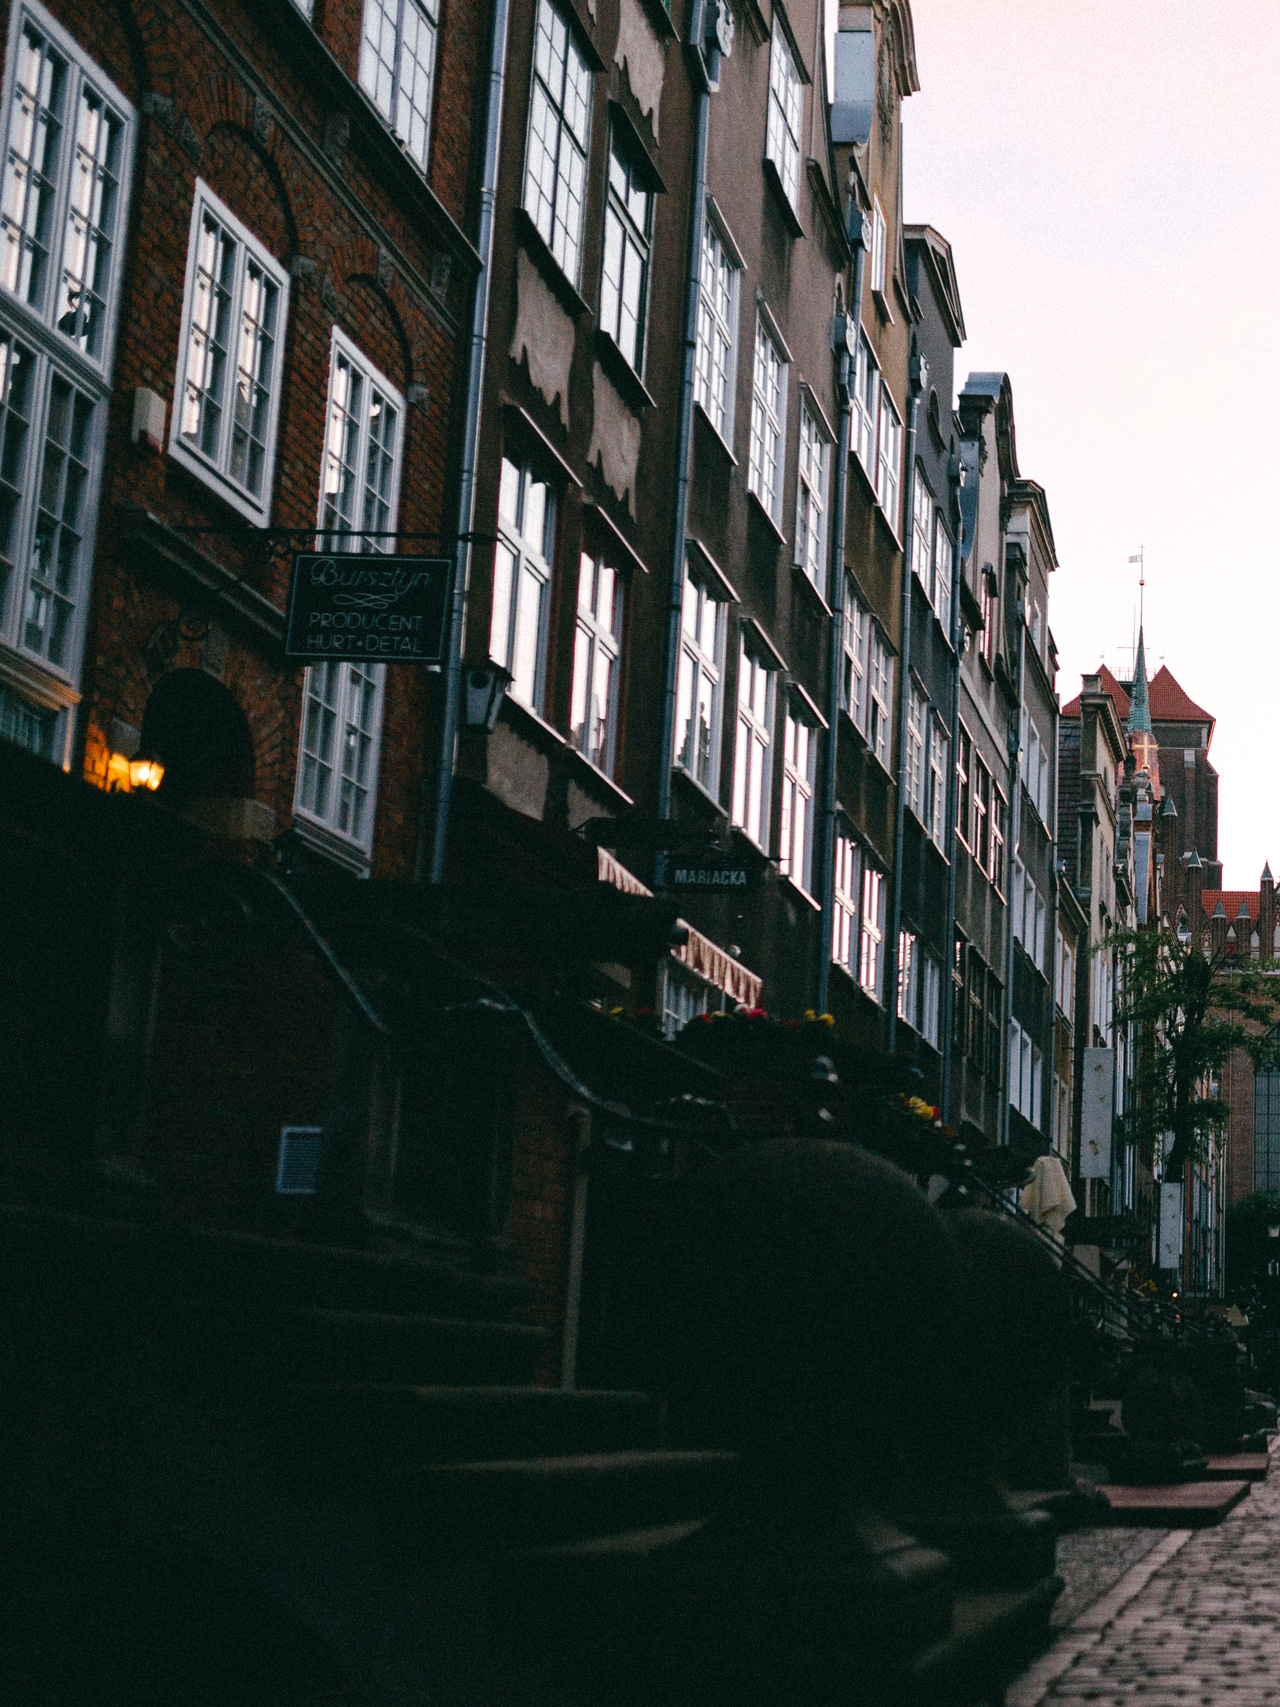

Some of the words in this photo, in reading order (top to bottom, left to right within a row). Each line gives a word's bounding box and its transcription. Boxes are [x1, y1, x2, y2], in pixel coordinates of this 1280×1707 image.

[311, 559, 432, 595] Bursztyn
[309, 612, 423, 631] PRODUCENT
[307, 634, 356, 650] HURT
[365, 634, 422, 653] DETAL
[674, 869, 747, 886] MARIACKA
